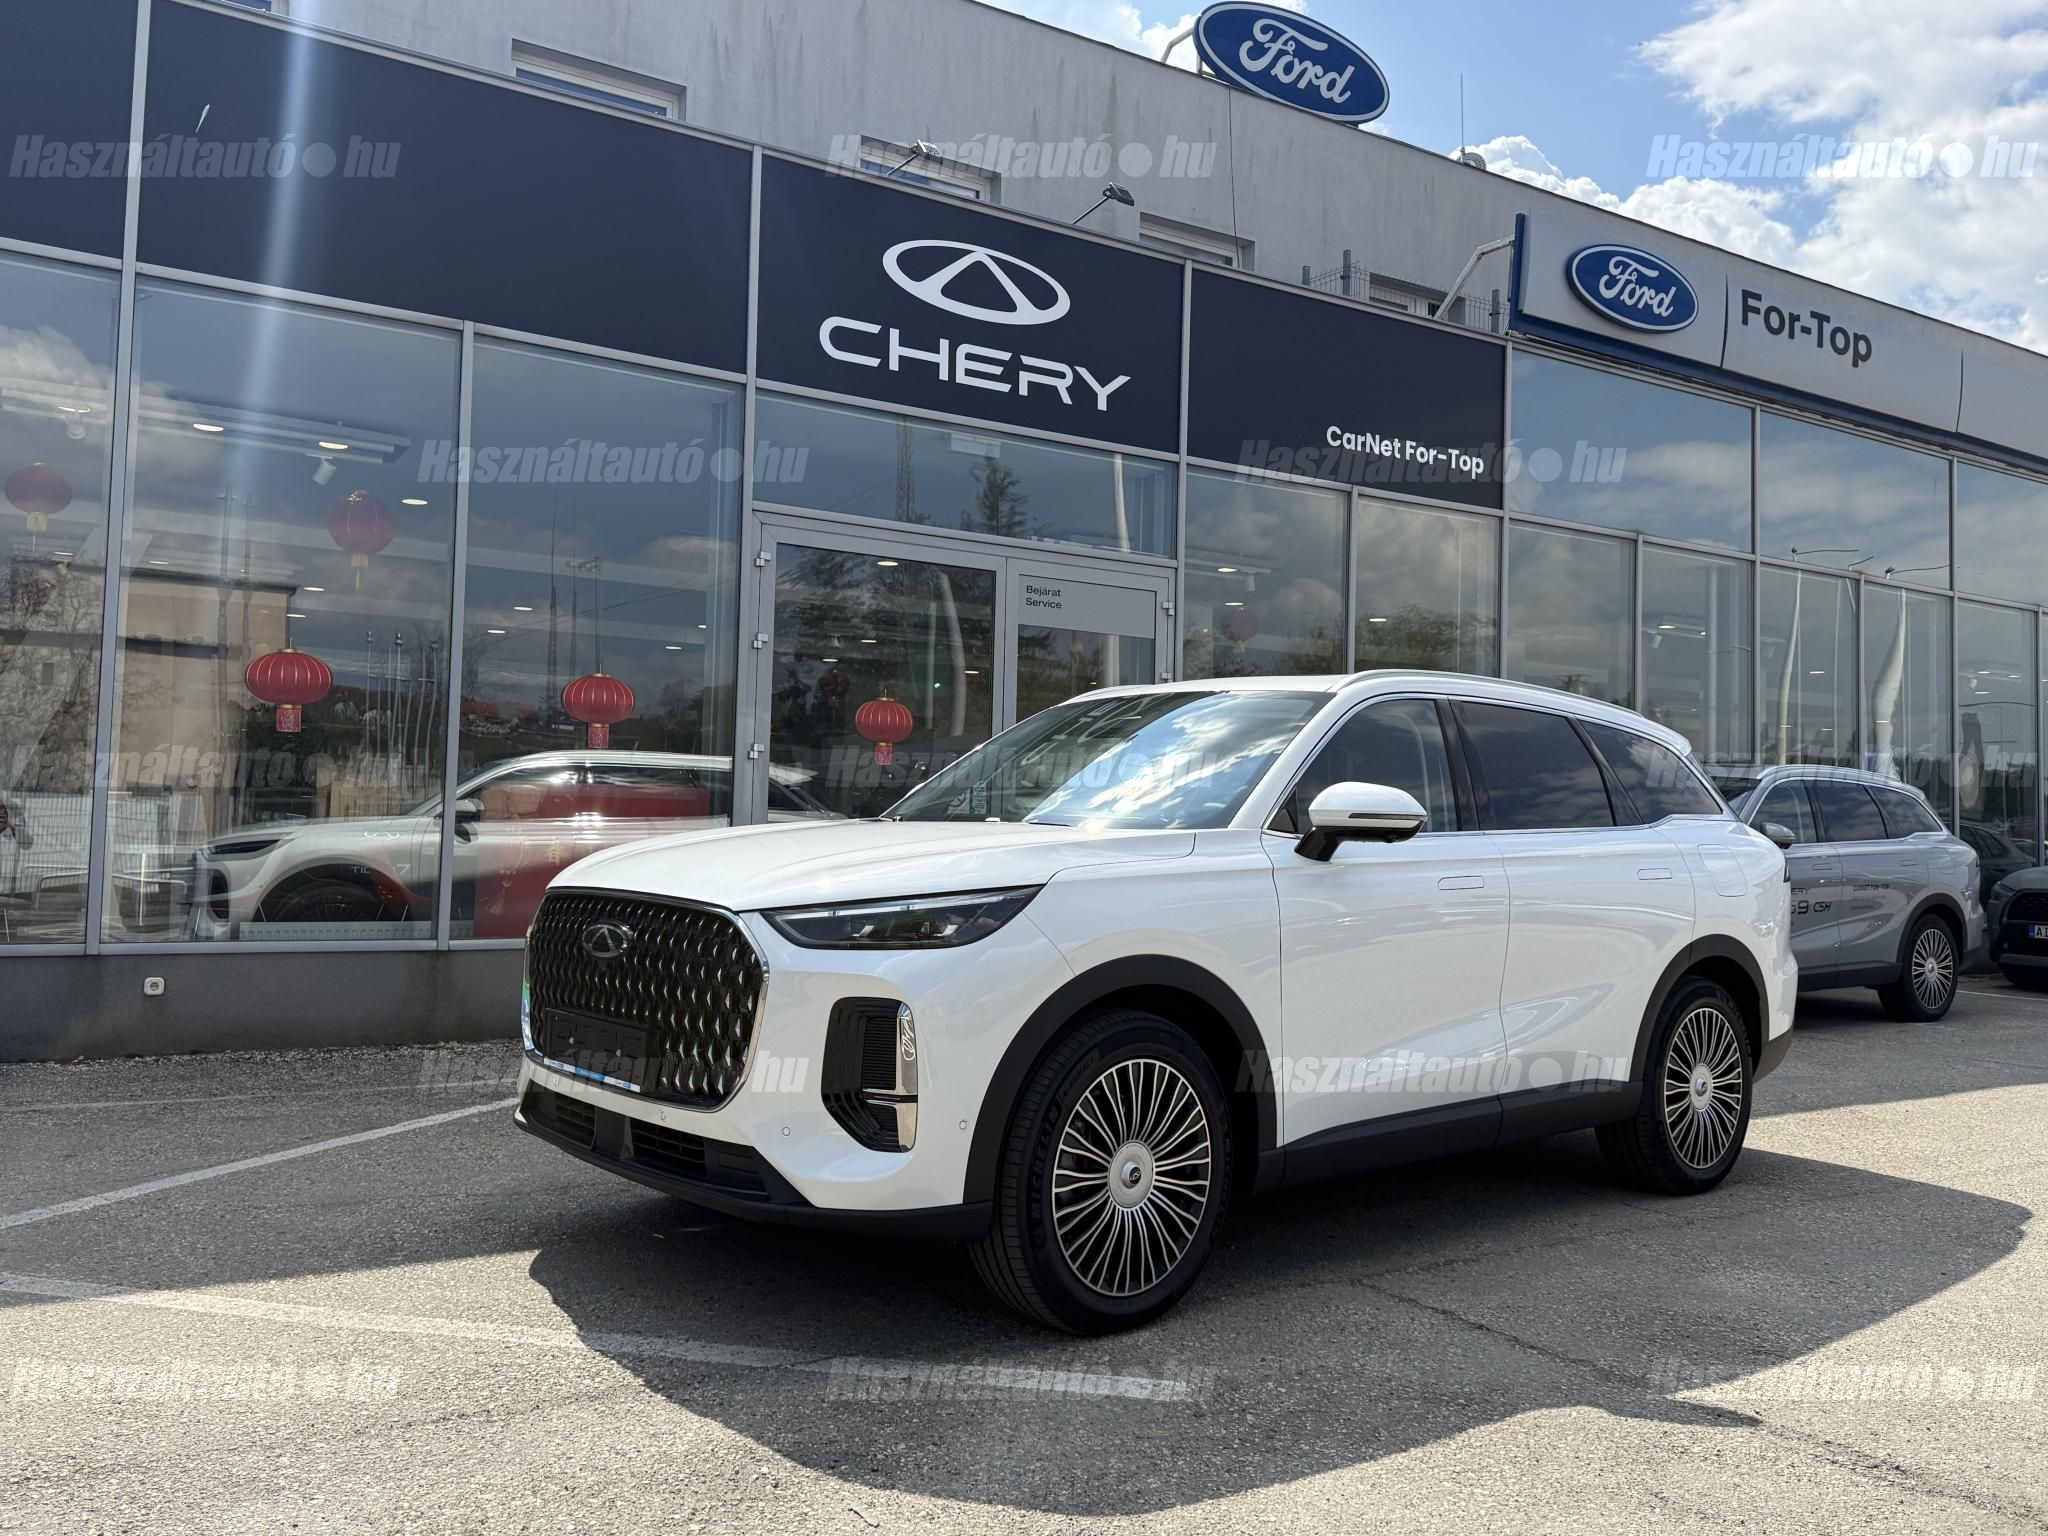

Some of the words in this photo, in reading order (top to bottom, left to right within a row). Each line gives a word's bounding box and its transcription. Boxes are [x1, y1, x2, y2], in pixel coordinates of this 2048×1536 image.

[1239, 19, 1355, 103] Ford
[1599, 256, 1677, 317] Ford
[1741, 289, 1871, 367] For-Top
[819, 316, 1131, 411] CHERY
[1326, 426, 1400, 459] CarNet
[1405, 440, 1484, 479] For-Top
[1025, 597, 1062, 609] Service
[1026, 585, 1061, 597] Bejárat
[1791, 887, 1809, 895] ERY
